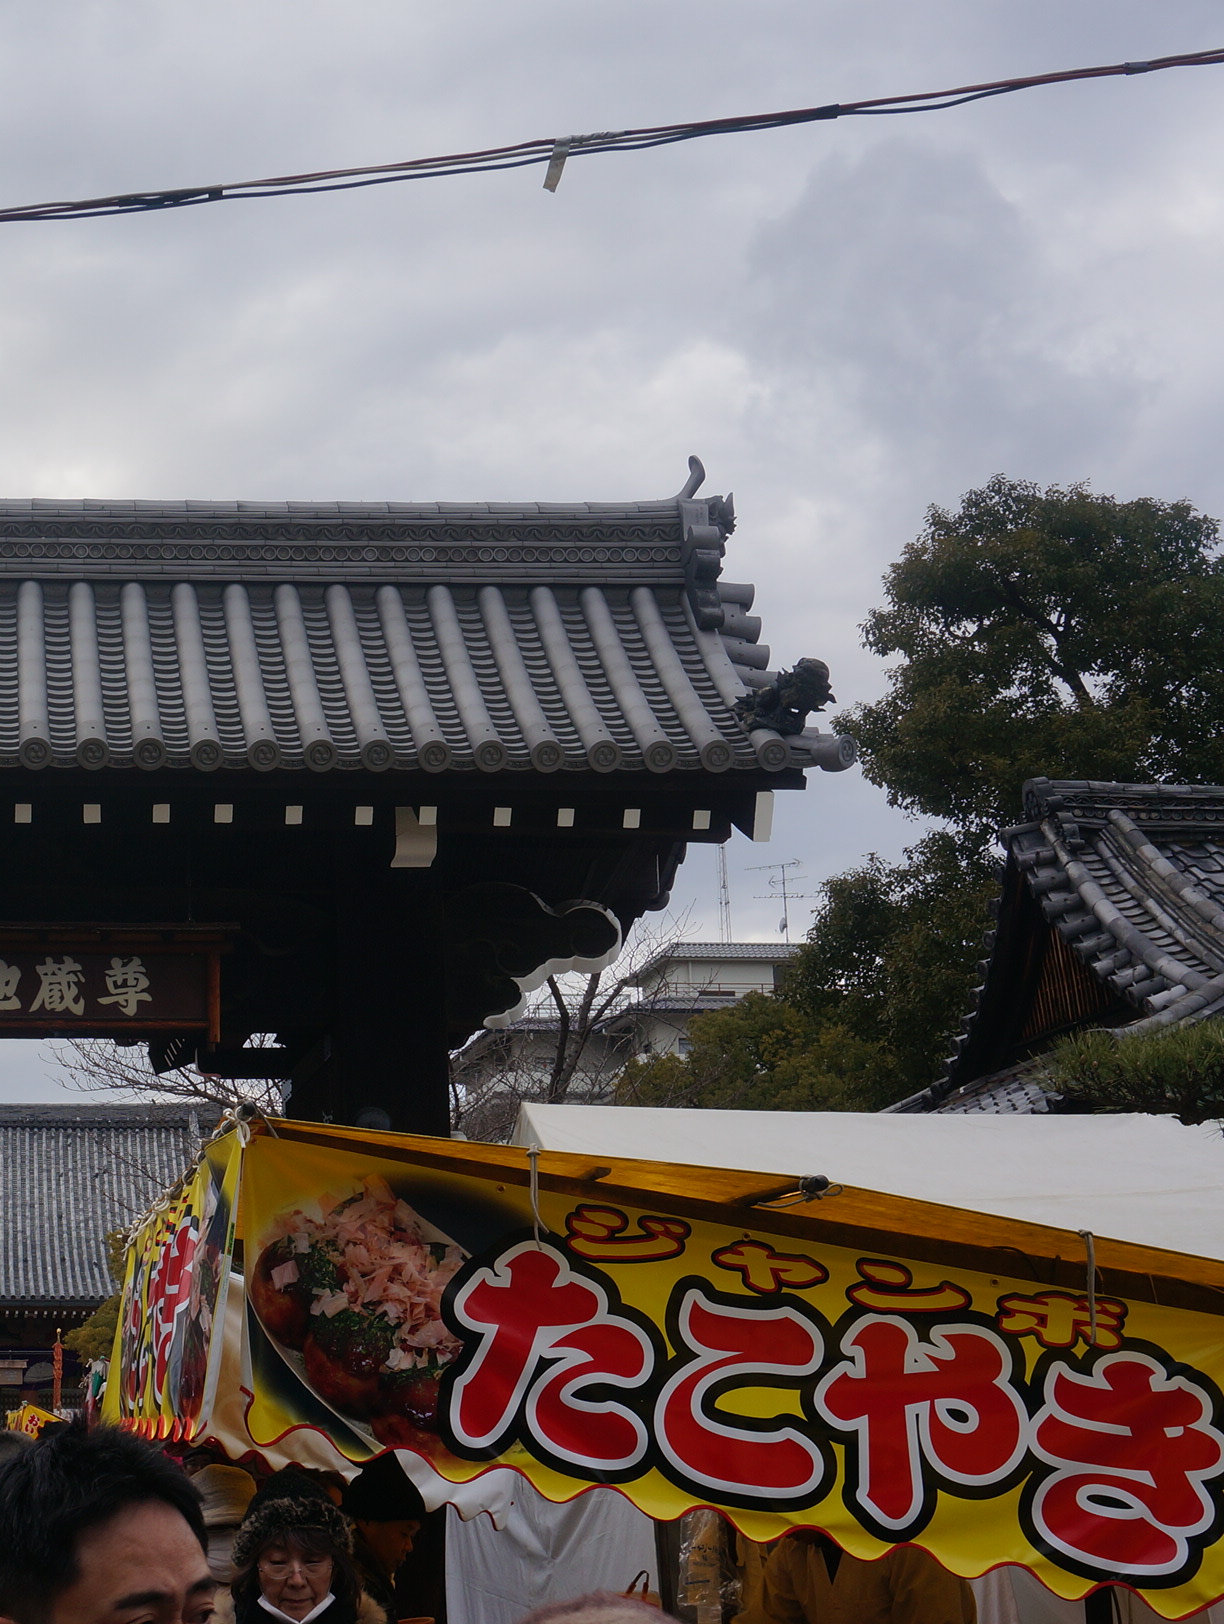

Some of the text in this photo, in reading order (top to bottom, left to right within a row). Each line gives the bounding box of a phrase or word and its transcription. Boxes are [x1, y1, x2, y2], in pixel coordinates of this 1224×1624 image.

[565, 1203, 1128, 1350] ジャンボ
[446, 1237, 1224, 1580] たこやき
